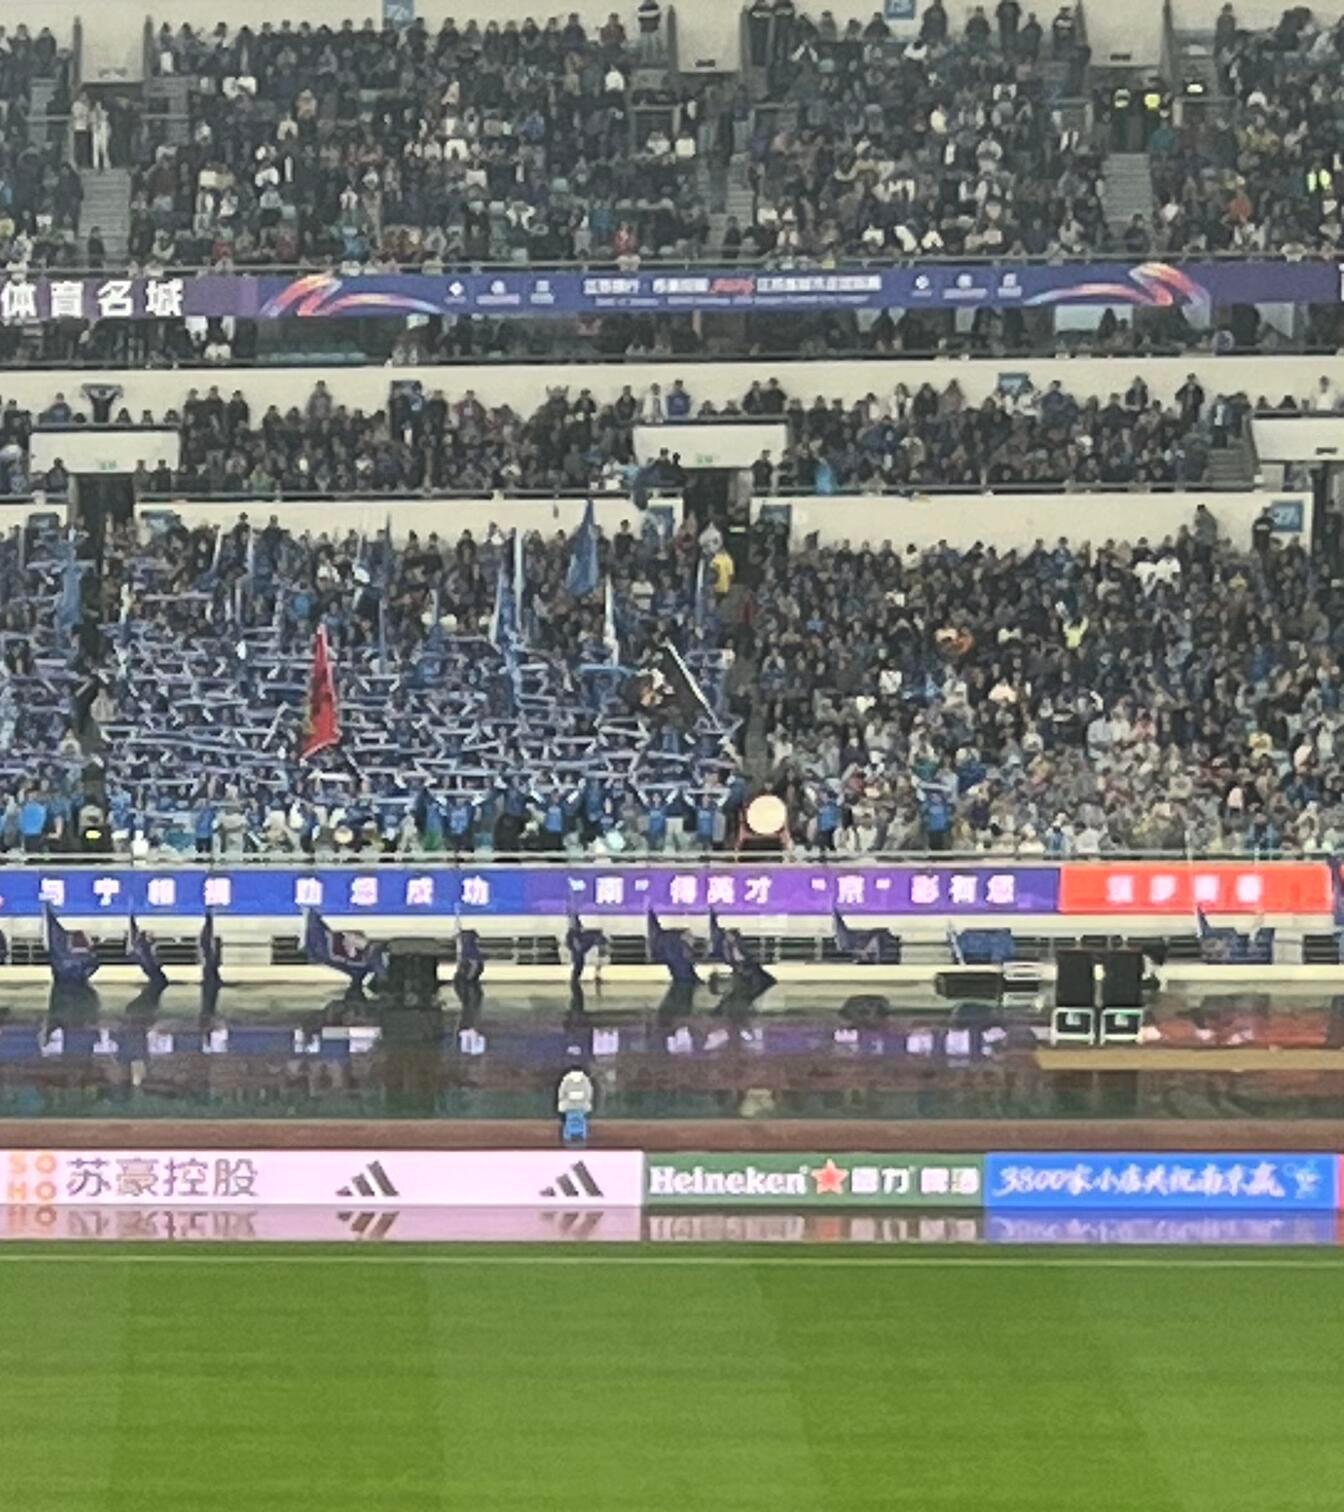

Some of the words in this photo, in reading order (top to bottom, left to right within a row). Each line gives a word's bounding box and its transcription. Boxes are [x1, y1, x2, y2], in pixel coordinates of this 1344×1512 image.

[67, 1157, 259, 1199] 苏豪控股
[649, 1166, 806, 1196] Heineken
